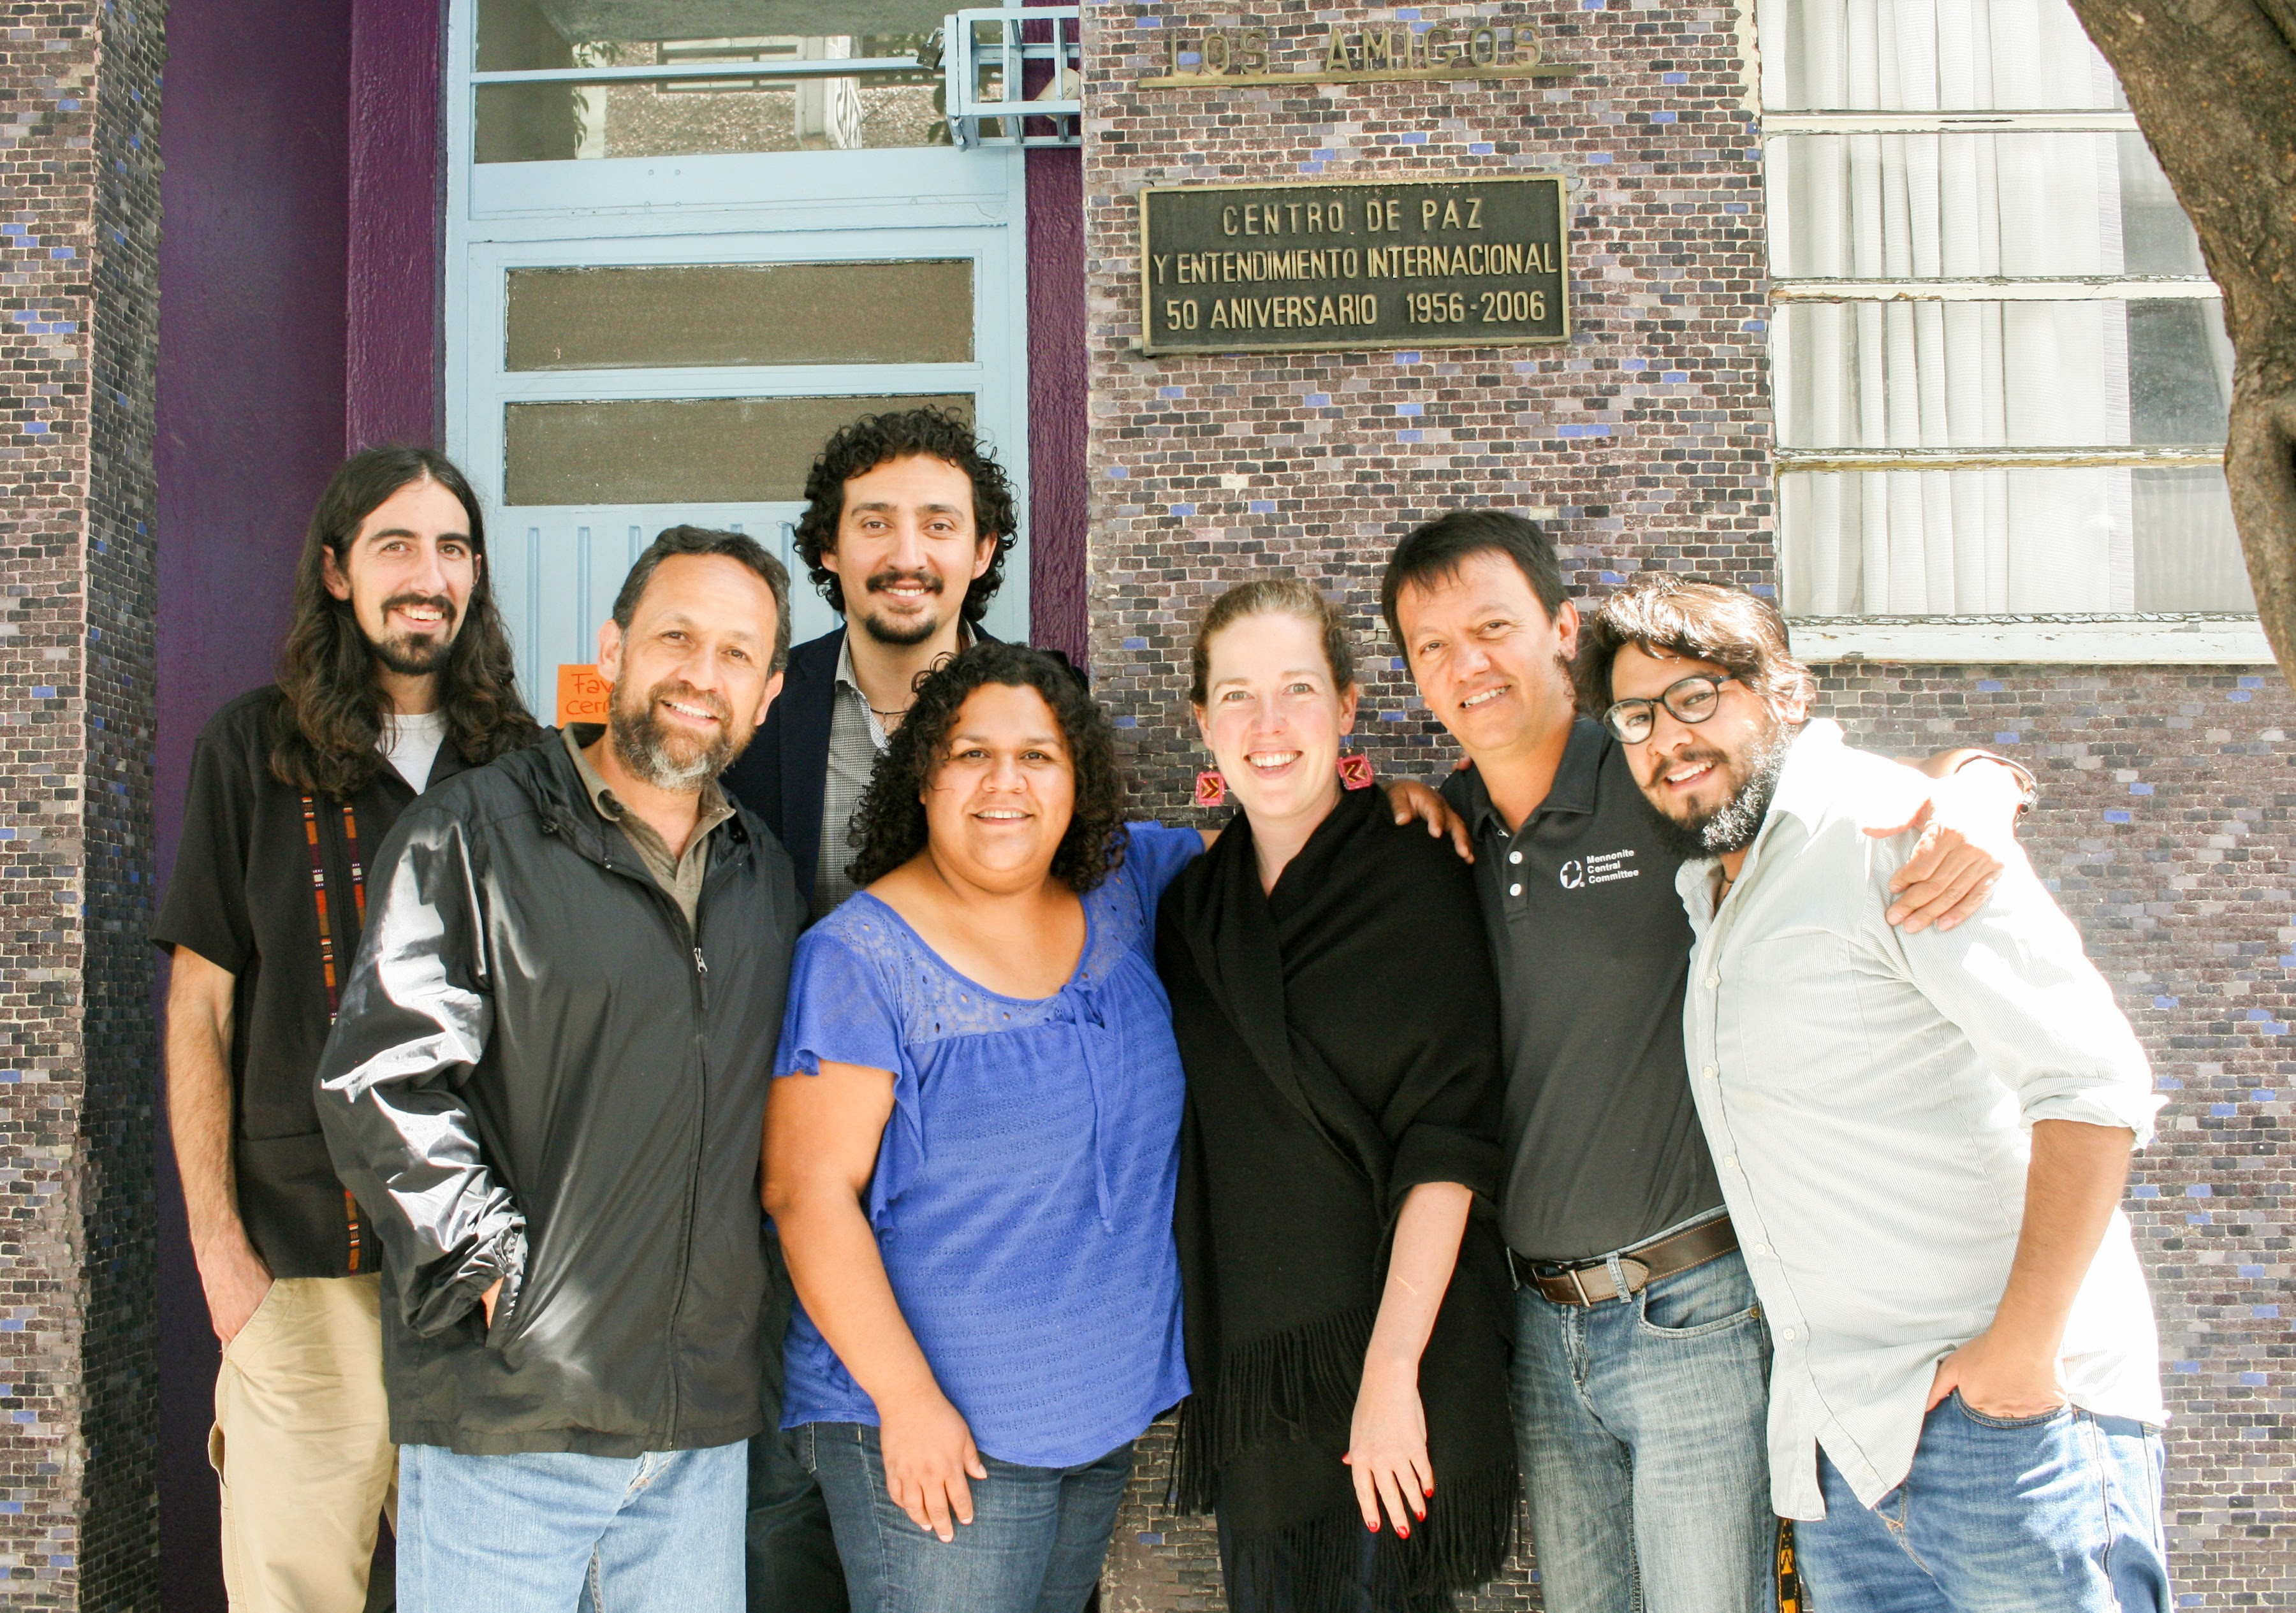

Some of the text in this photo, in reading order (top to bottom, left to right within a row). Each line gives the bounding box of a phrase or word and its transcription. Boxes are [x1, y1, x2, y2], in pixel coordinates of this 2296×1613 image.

[1171, 23, 1541, 76] LOS AMIGOS
[1222, 198, 1482, 236] CENTRO DE PAZ
[1153, 243, 1558, 285] Y ENTENDIMIENTO INTERNACIONAL
[1166, 299, 1199, 331] 50
[1210, 293, 1377, 330] ANIVERSARIO
[1586, 849, 1635, 864] Mennonite
[1587, 861, 1621, 874] Central
[1588, 869, 1639, 884] Committee
